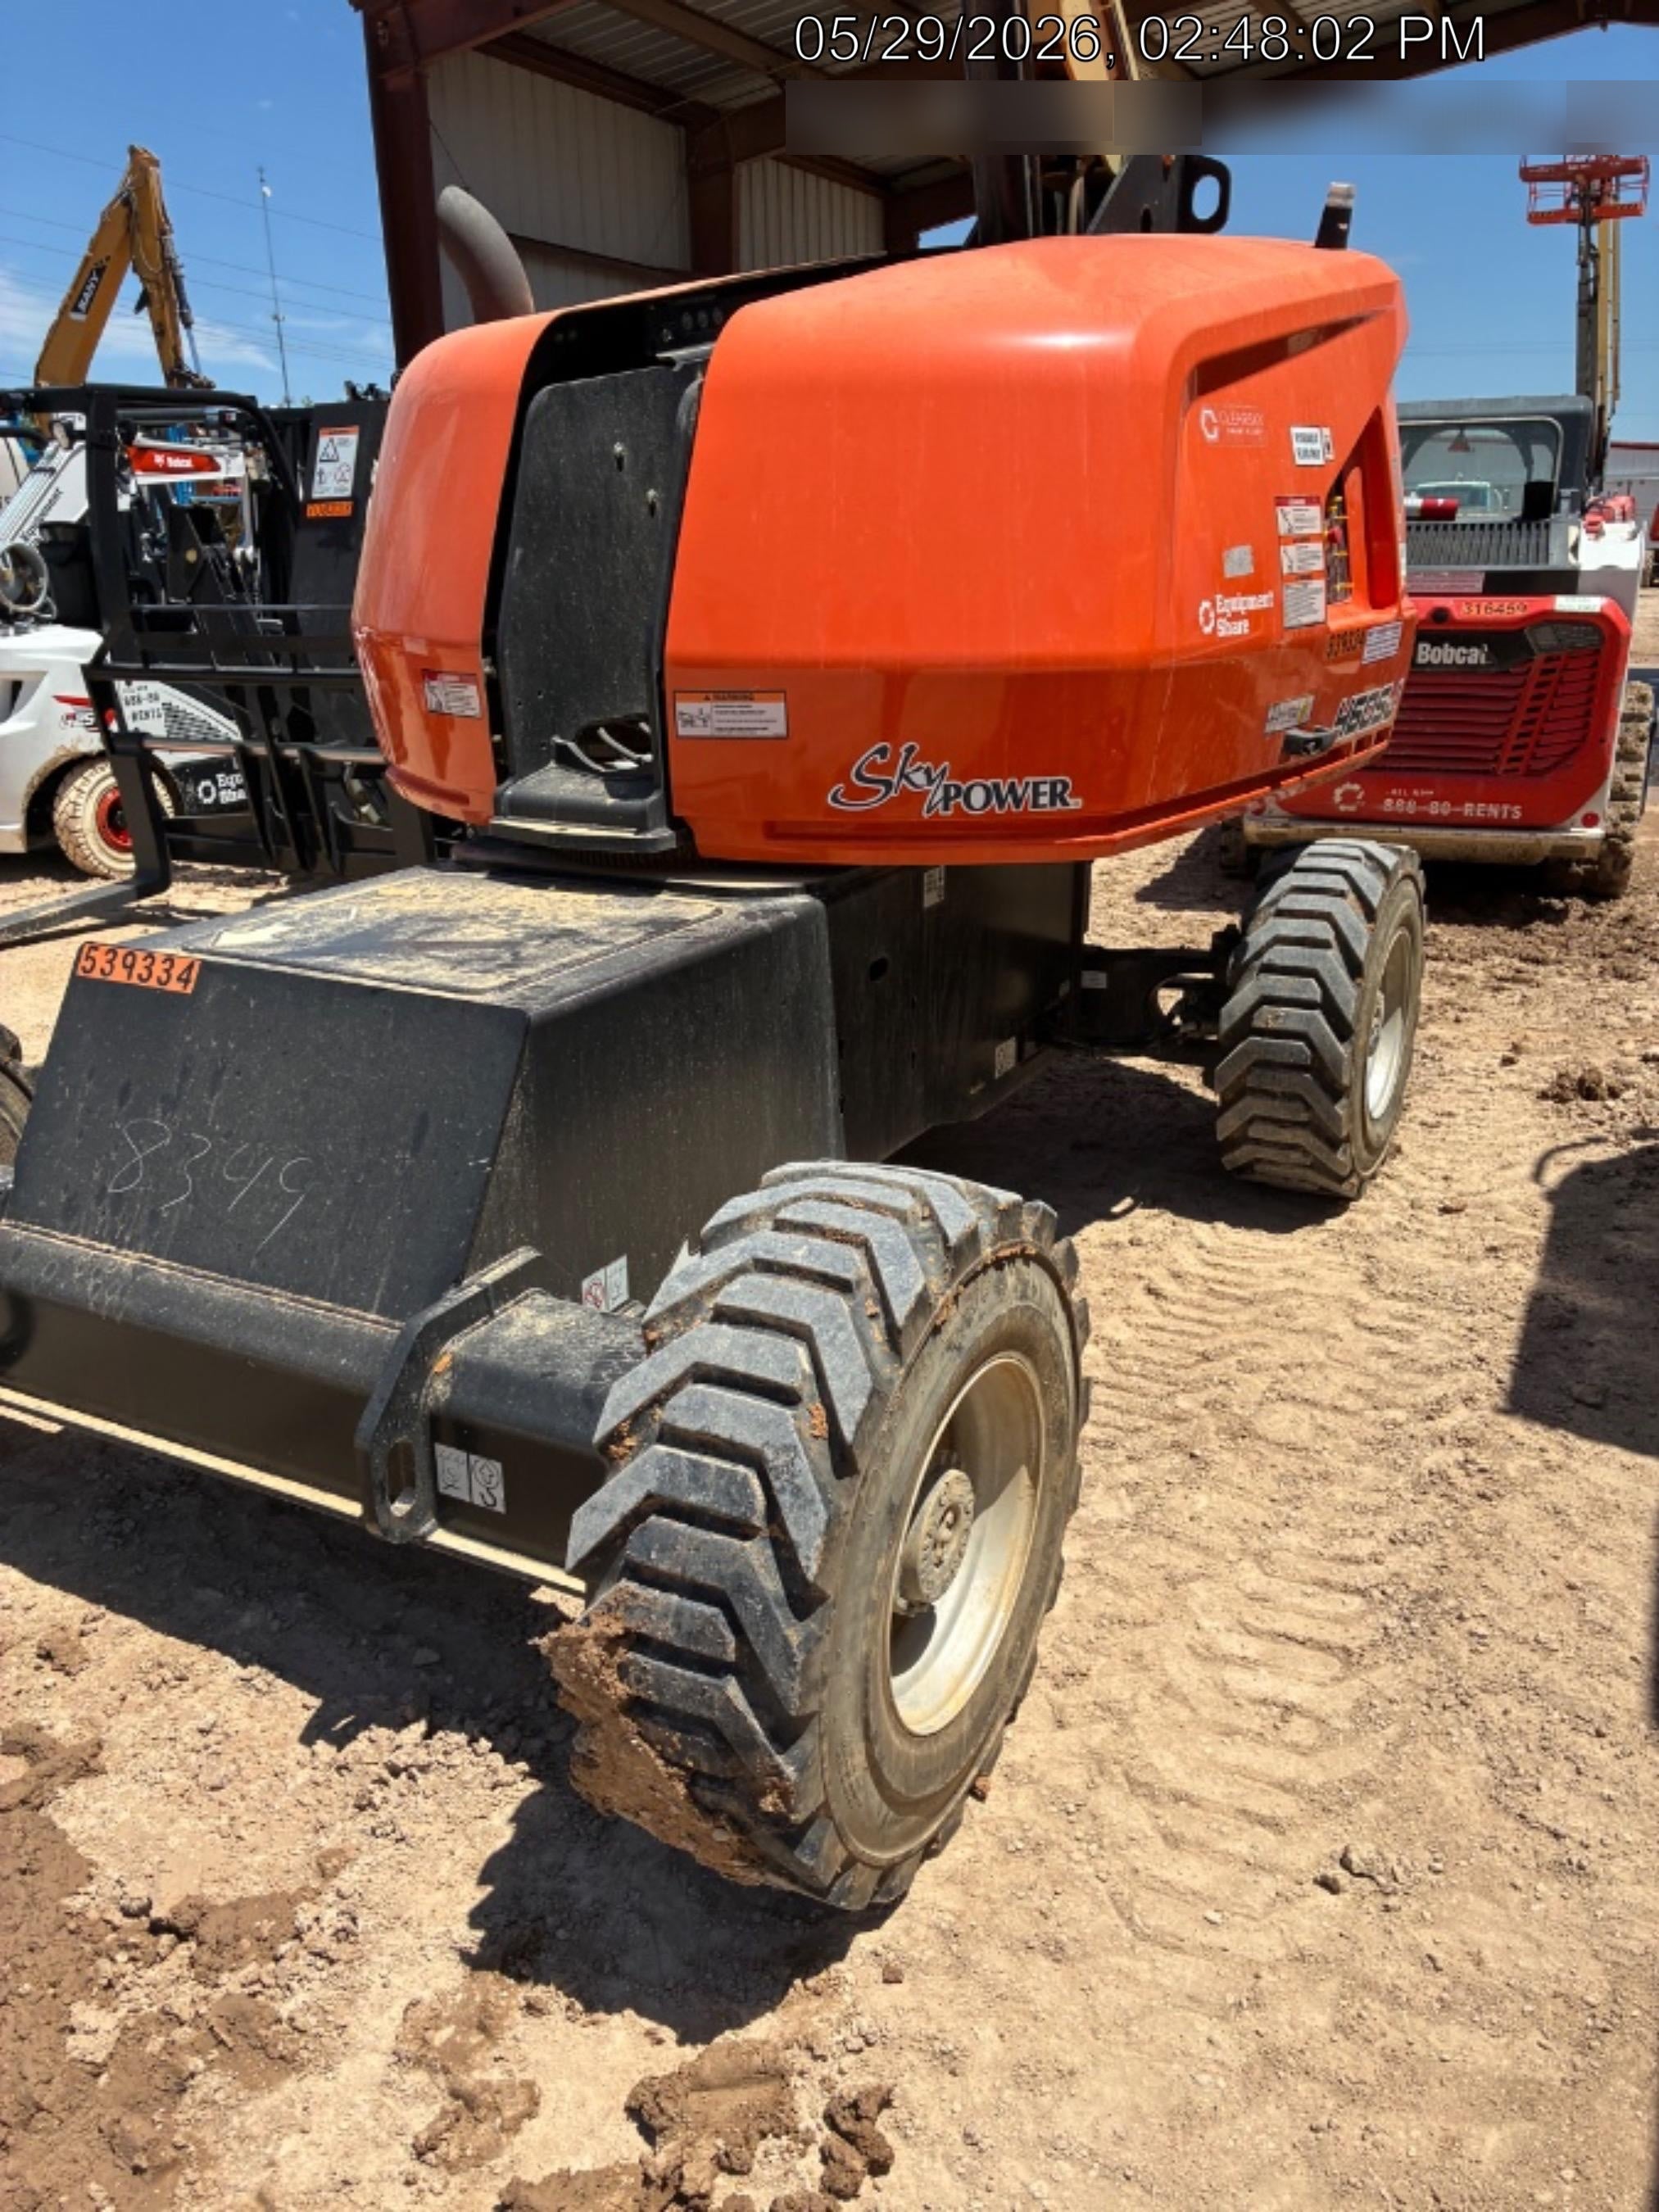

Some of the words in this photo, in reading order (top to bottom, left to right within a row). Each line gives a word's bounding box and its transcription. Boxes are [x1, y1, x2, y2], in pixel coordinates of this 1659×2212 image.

[1215, 589, 1275, 617] Equipment
[1462, 601, 1527, 614] 316459
[1217, 619, 1250, 638] Share
[1416, 642, 1489, 664] Bobcat
[80, 945, 196, 990] 539334
